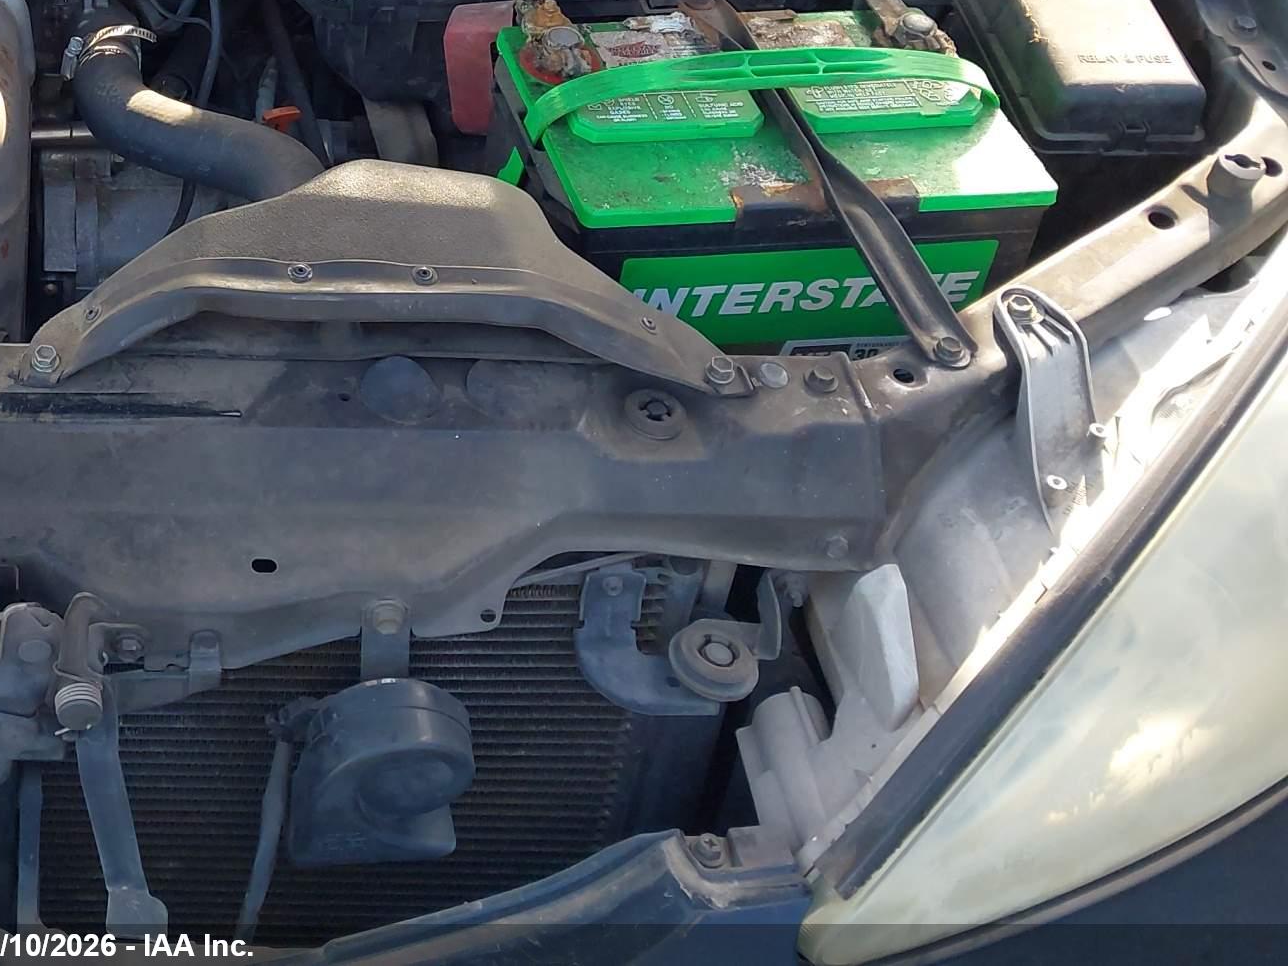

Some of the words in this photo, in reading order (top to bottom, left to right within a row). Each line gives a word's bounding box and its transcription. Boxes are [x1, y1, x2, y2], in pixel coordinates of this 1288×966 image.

[1077, 54, 1119, 64] RELAY
[1136, 54, 1172, 64] FUSE
[633, 271, 980, 318] NTERSTAE
